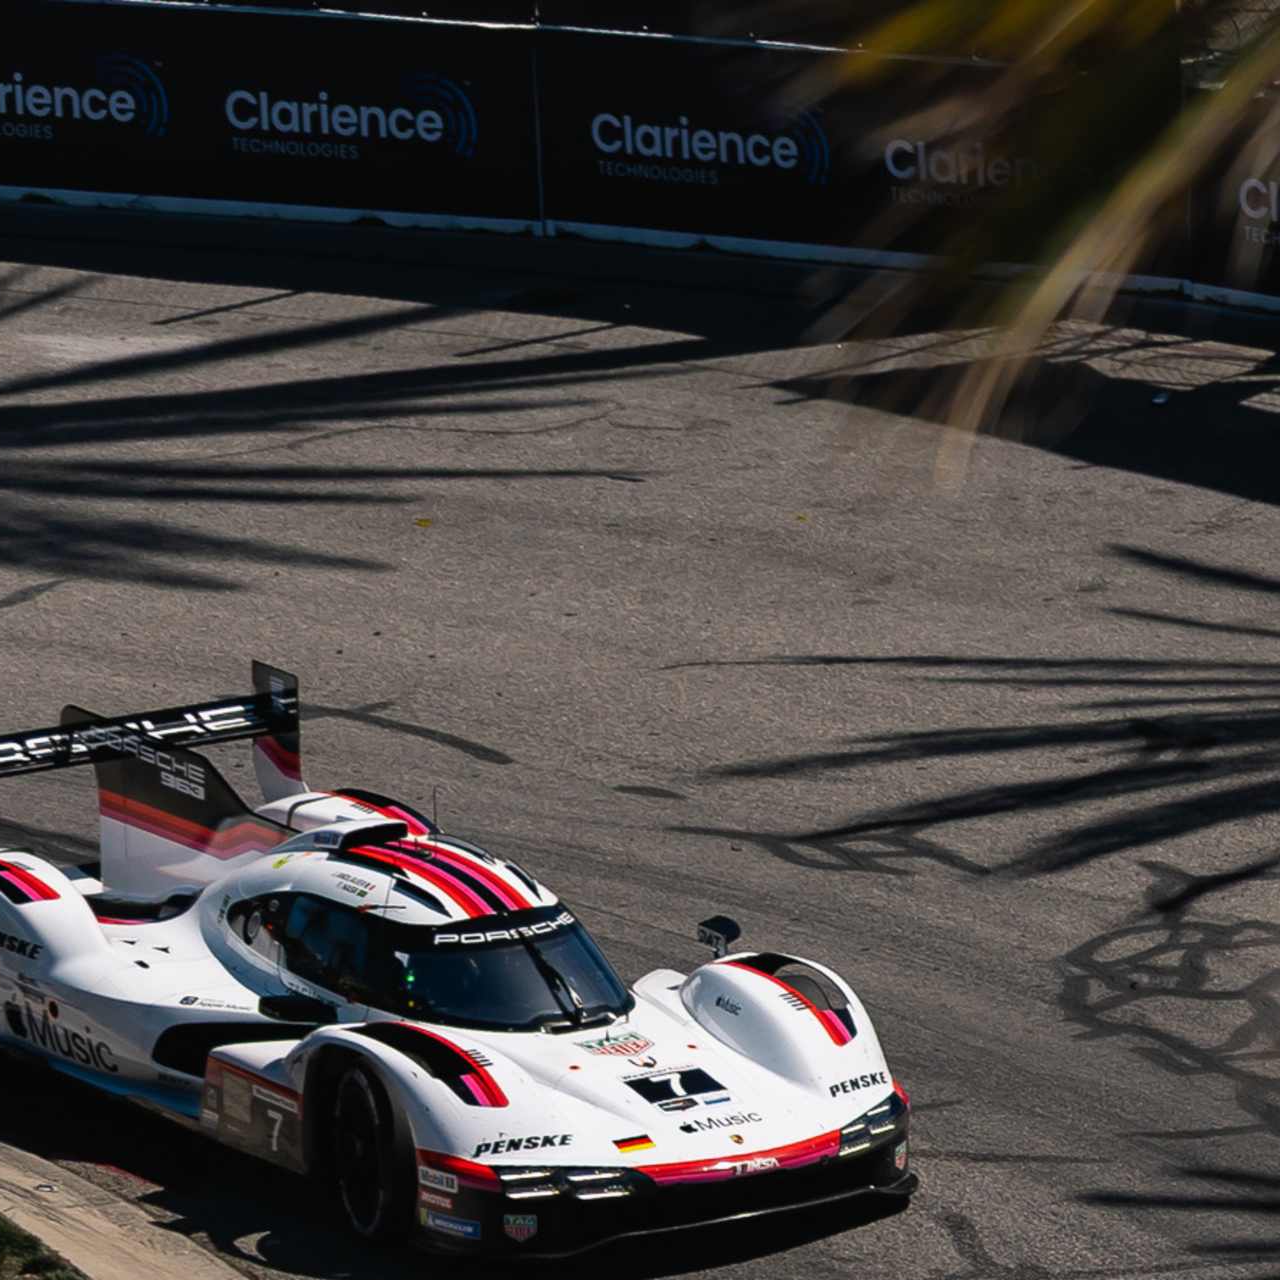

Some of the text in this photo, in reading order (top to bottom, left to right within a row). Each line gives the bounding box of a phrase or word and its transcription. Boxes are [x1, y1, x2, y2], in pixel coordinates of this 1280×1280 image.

[225, 88, 443, 143] Clarience
[232, 137, 359, 159] TECHNOLOGIES
[591, 112, 799, 170] Clarience
[598, 160, 719, 185] TECHNOLOGIES
[883, 139, 1042, 187] Clarien
[160, 770, 206, 800] 963
[432, 911, 576, 948] PORSCHE
[26, 1001, 119, 1073] Music
[649, 1073, 688, 1097] 7
[829, 1071, 889, 1098] PENSKE
[266, 1108, 284, 1153] 7
[696, 1111, 762, 1132] Music
[473, 1134, 575, 1159] PENSKE
